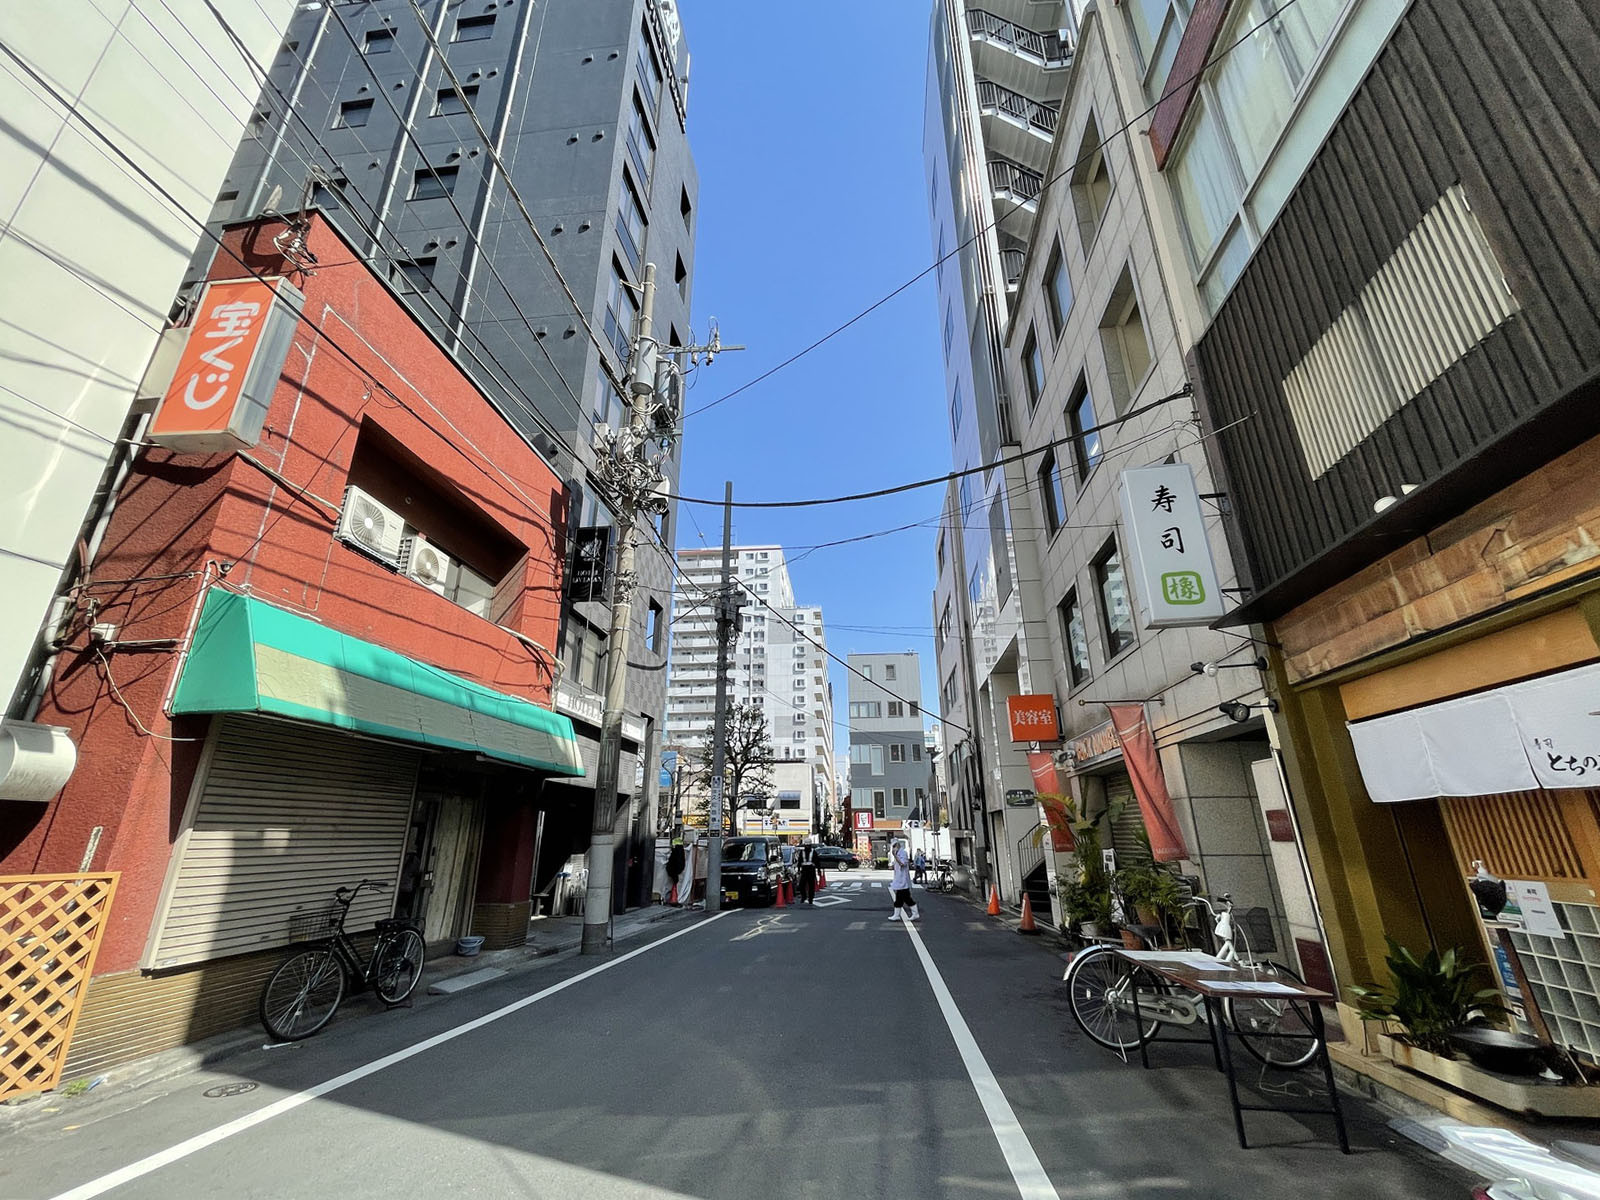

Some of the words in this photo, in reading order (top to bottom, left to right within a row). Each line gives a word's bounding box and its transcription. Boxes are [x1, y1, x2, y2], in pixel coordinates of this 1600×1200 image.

[184, 301, 260, 410] 宝くじ
[1151, 484, 1185, 554] 寿司
[1013, 708, 1054, 727] 美容室
[1546, 751, 1600, 777] とちの
